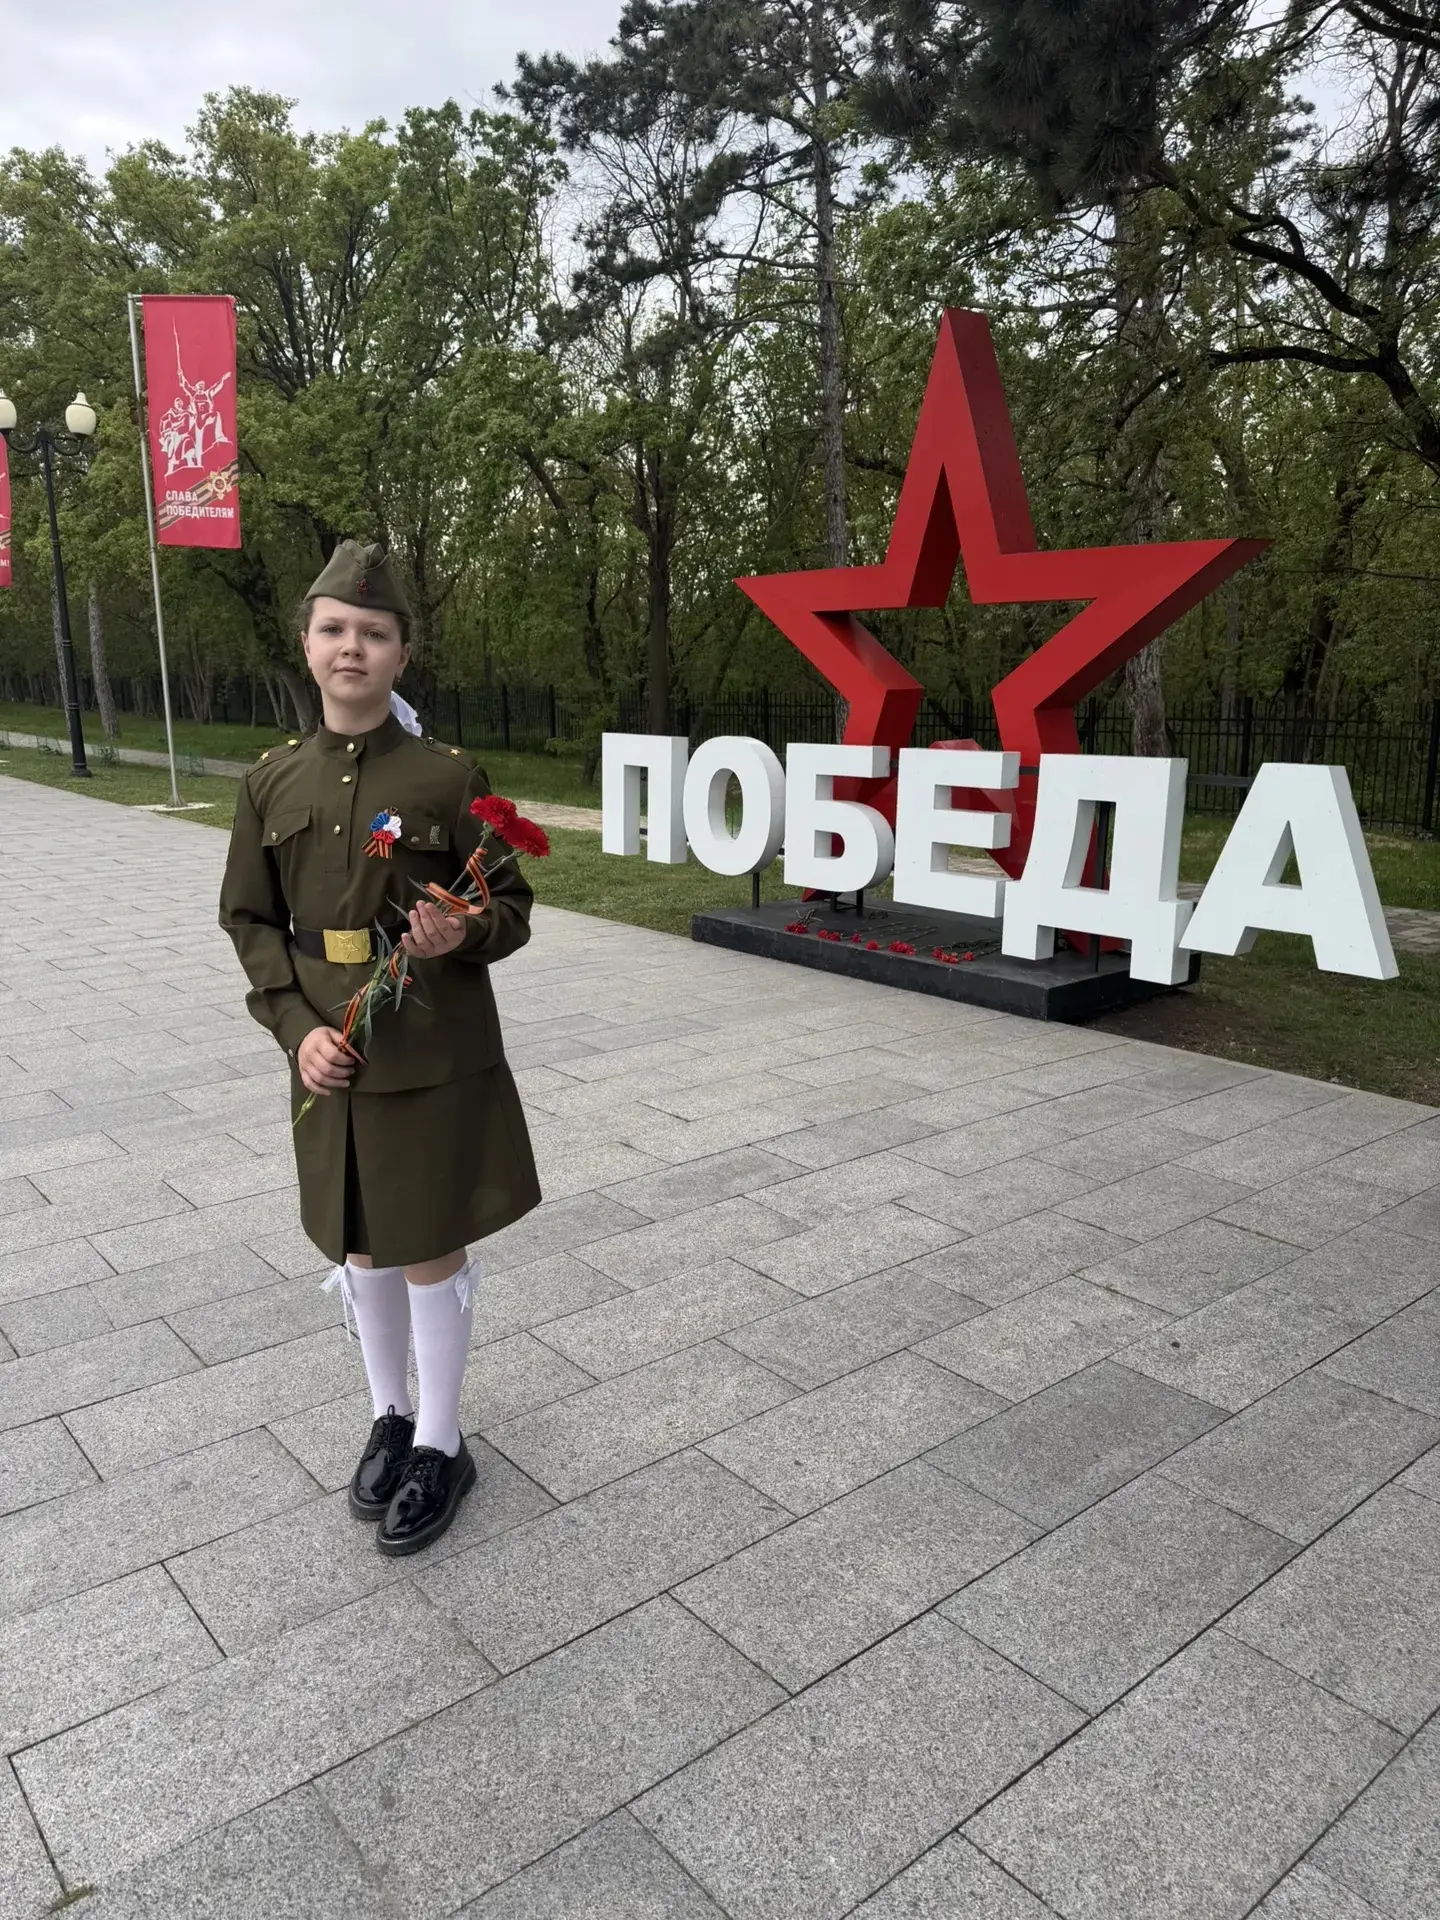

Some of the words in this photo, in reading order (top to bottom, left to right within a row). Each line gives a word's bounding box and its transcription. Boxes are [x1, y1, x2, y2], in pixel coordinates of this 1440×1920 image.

[166, 489, 198, 501] СЛАВА
[166, 505, 234, 519] ПОБЕДИТЕЛЯМ
[601, 733, 1399, 985] ПОБЕДА
